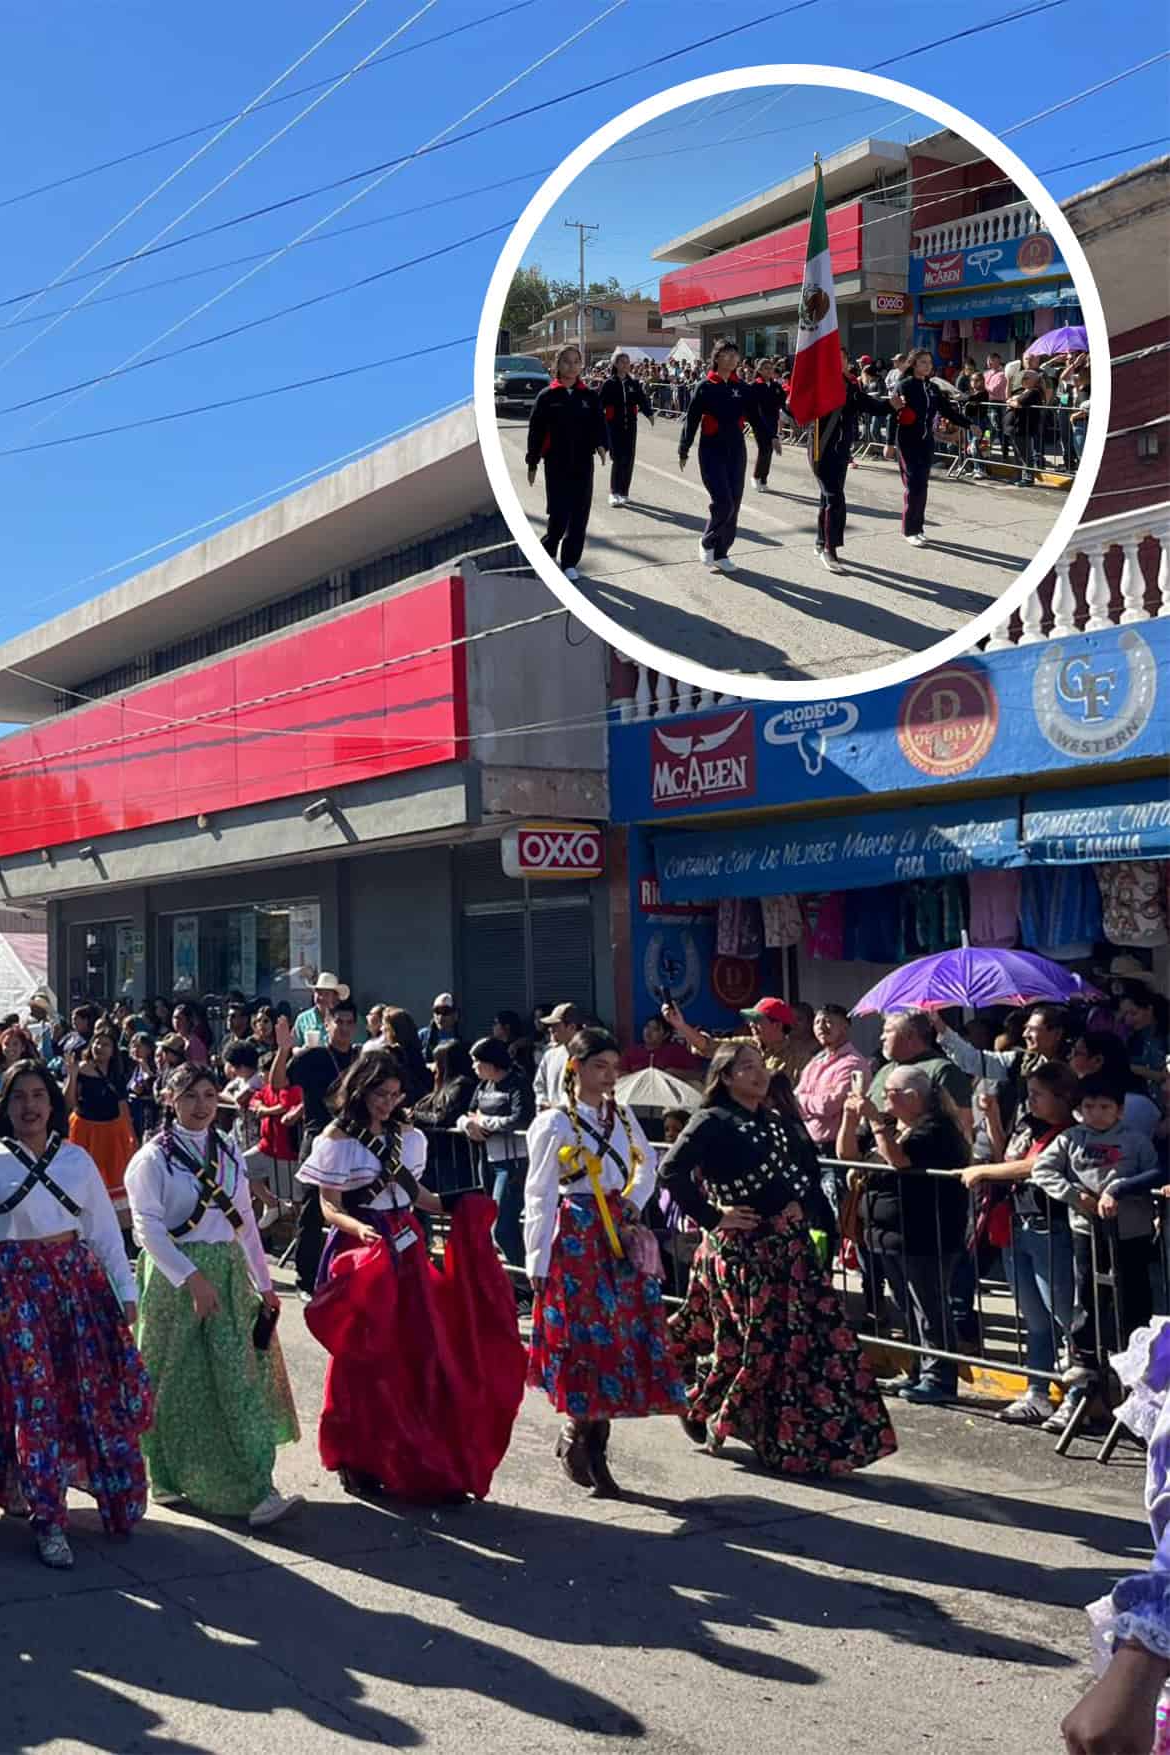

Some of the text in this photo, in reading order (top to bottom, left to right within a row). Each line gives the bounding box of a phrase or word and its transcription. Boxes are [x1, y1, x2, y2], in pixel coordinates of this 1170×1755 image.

[878, 297, 904, 309] OXXO
[784, 701, 838, 725] RODEO
[1053, 719, 1140, 754] WESTERN
[522, 832, 598, 867] OXXO
[725, 849, 757, 874] CON
[759, 846, 780, 870] LAS
[783, 840, 837, 866] MEJORES
[841, 832, 894, 859] MARCAS
[1046, 834, 1141, 860] LA FAMILIA
[895, 851, 973, 879] PARA TODA
